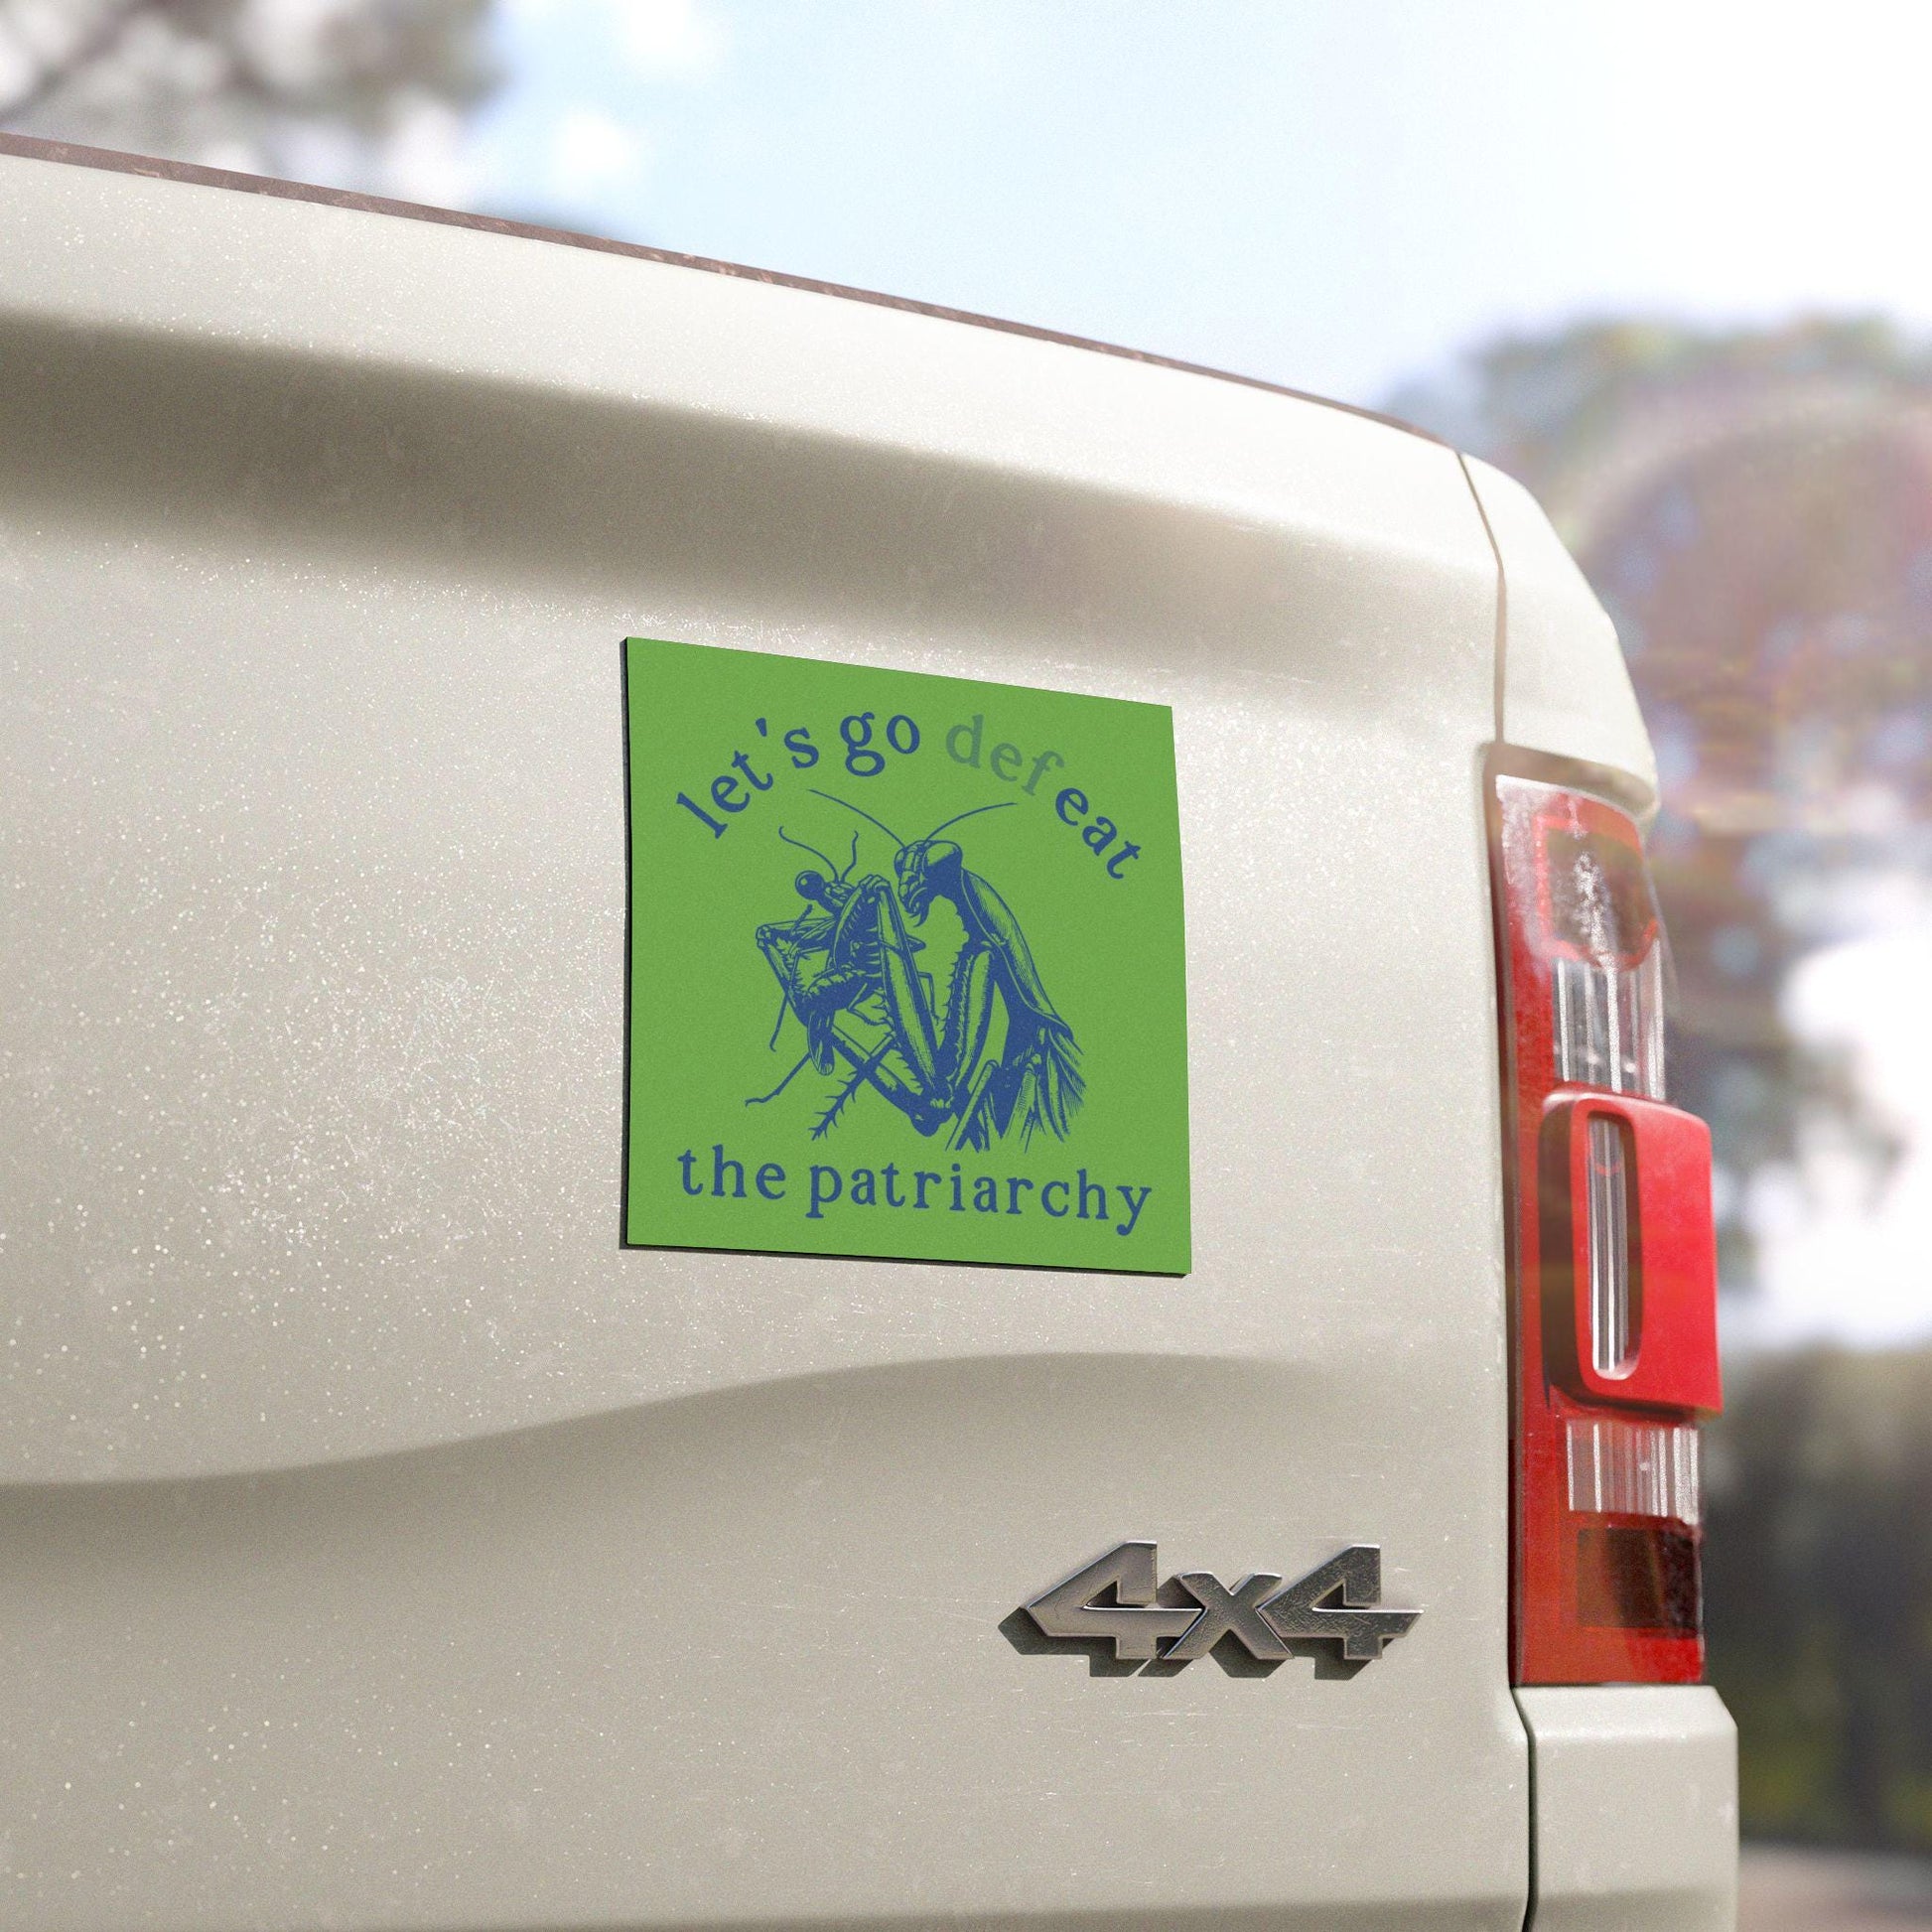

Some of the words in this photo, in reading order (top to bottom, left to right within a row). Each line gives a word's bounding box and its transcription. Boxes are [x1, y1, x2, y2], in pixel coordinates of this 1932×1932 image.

[675, 716, 821, 841] let's
[838, 710, 922, 778] go
[676, 1143, 787, 1201] the
[804, 1163, 1153, 1238] patriarchy
